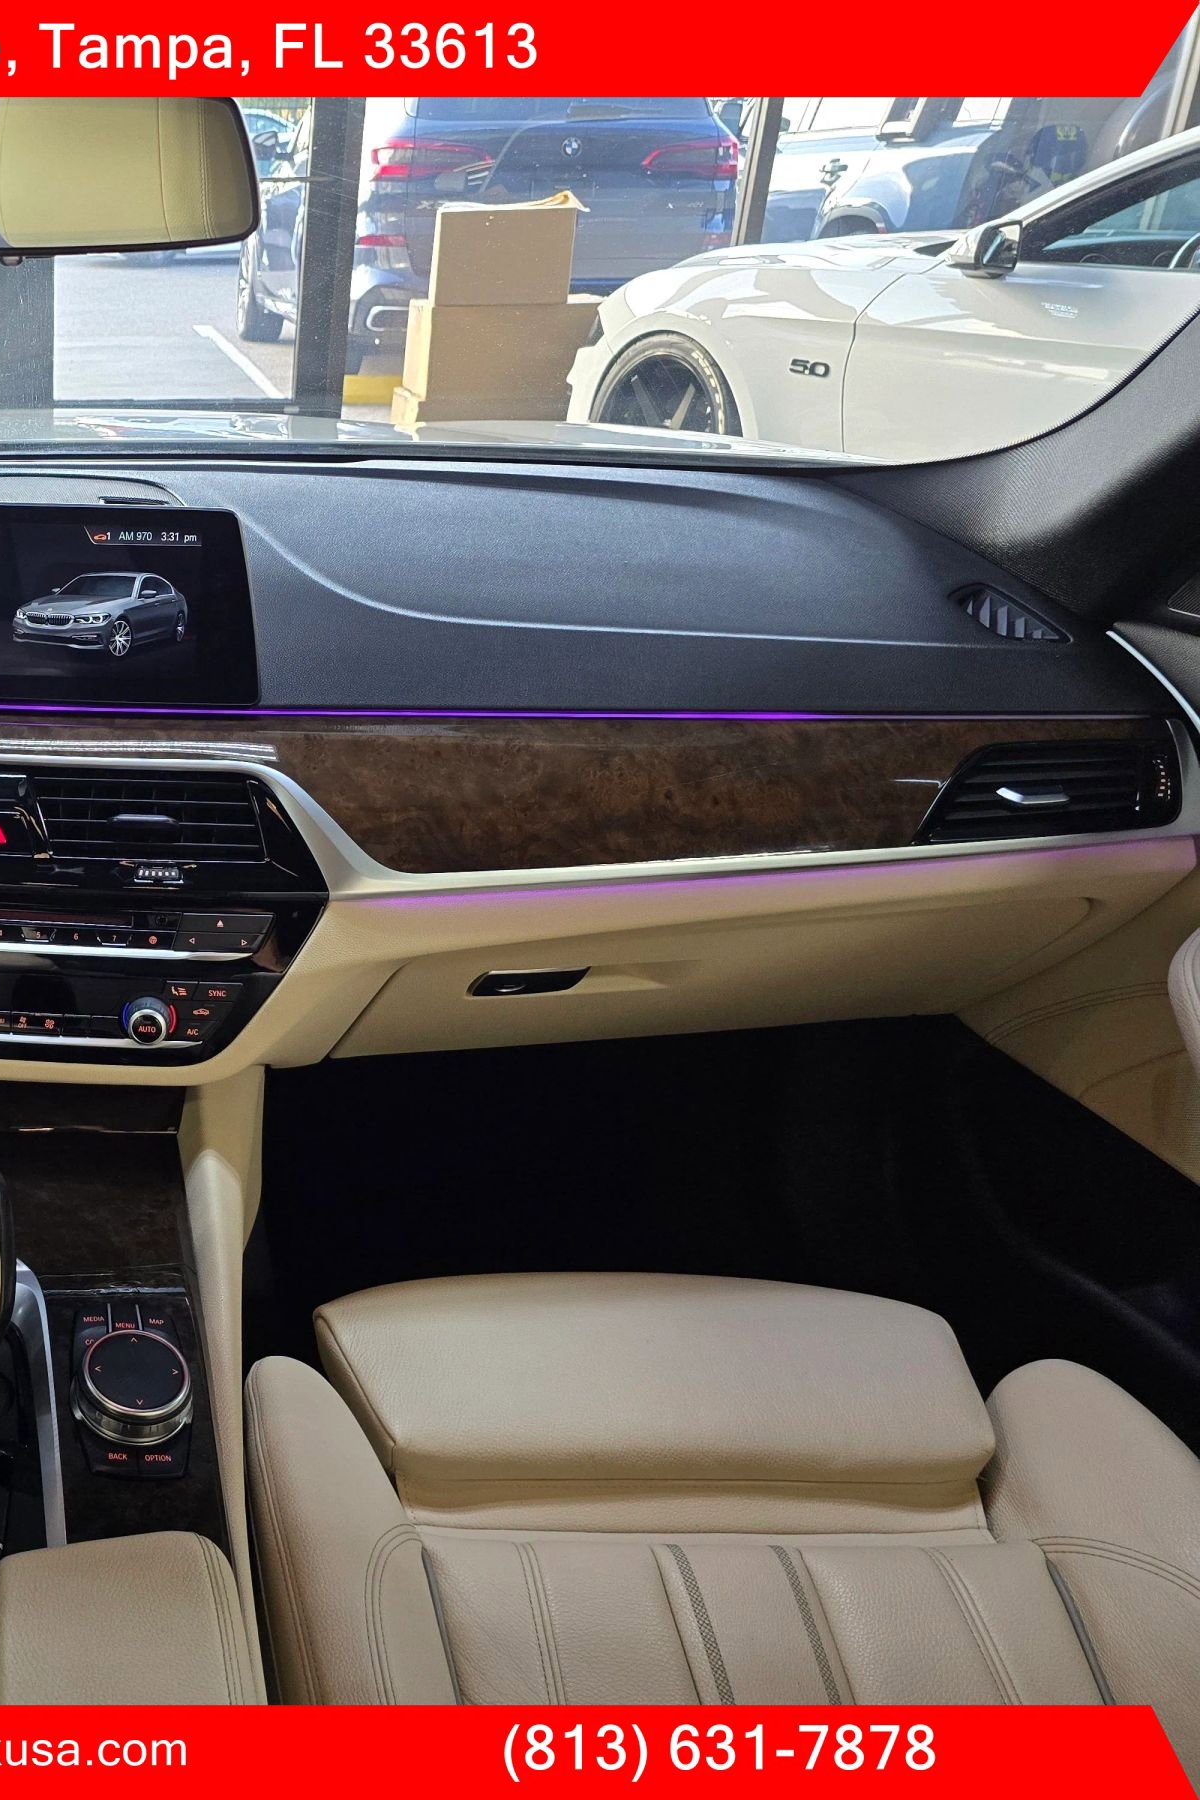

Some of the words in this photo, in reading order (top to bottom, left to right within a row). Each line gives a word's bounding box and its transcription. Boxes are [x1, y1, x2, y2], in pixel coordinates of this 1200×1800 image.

[118, 531, 135, 542] AM
[136, 531, 153, 542] 970
[161, 531, 180, 543] 3:31
[184, 534, 197, 545] pm
[208, 989, 227, 998] SYNC
[138, 1025, 156, 1034] AUTO
[187, 1027, 199, 1036] A/C
[108, 1453, 128, 1461] BACK
[144, 1454, 171, 1462] OPTION
